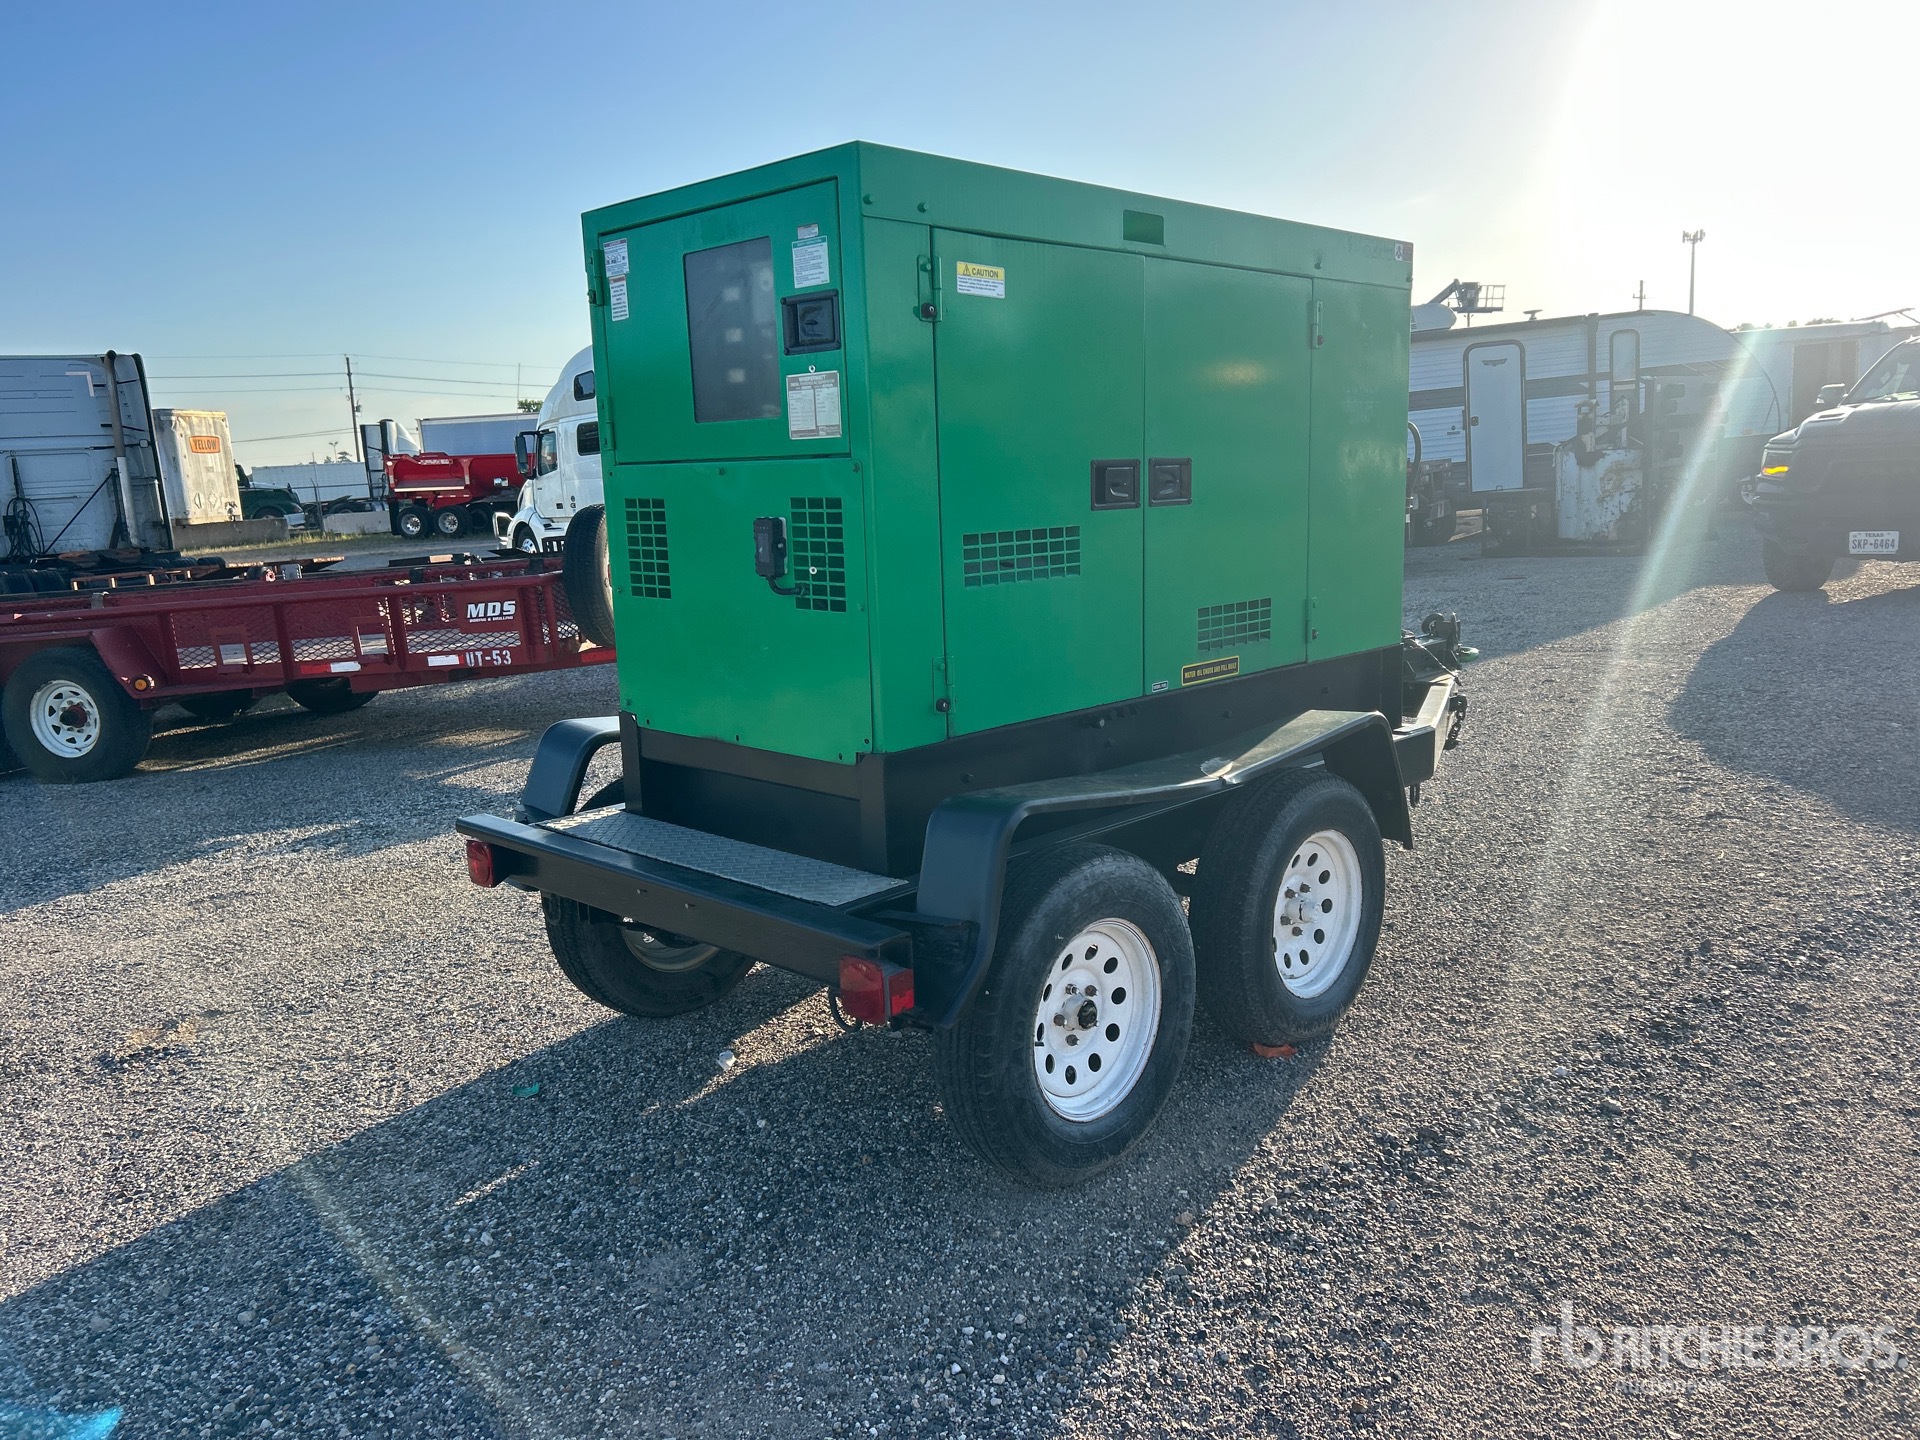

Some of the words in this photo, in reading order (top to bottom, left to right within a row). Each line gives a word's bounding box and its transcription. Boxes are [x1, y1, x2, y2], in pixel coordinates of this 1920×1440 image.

[971, 267, 999, 279] CAUTION
[193, 439, 217, 450] YELLOW
[467, 600, 516, 618] MDS
[466, 650, 512, 667] UT-53
